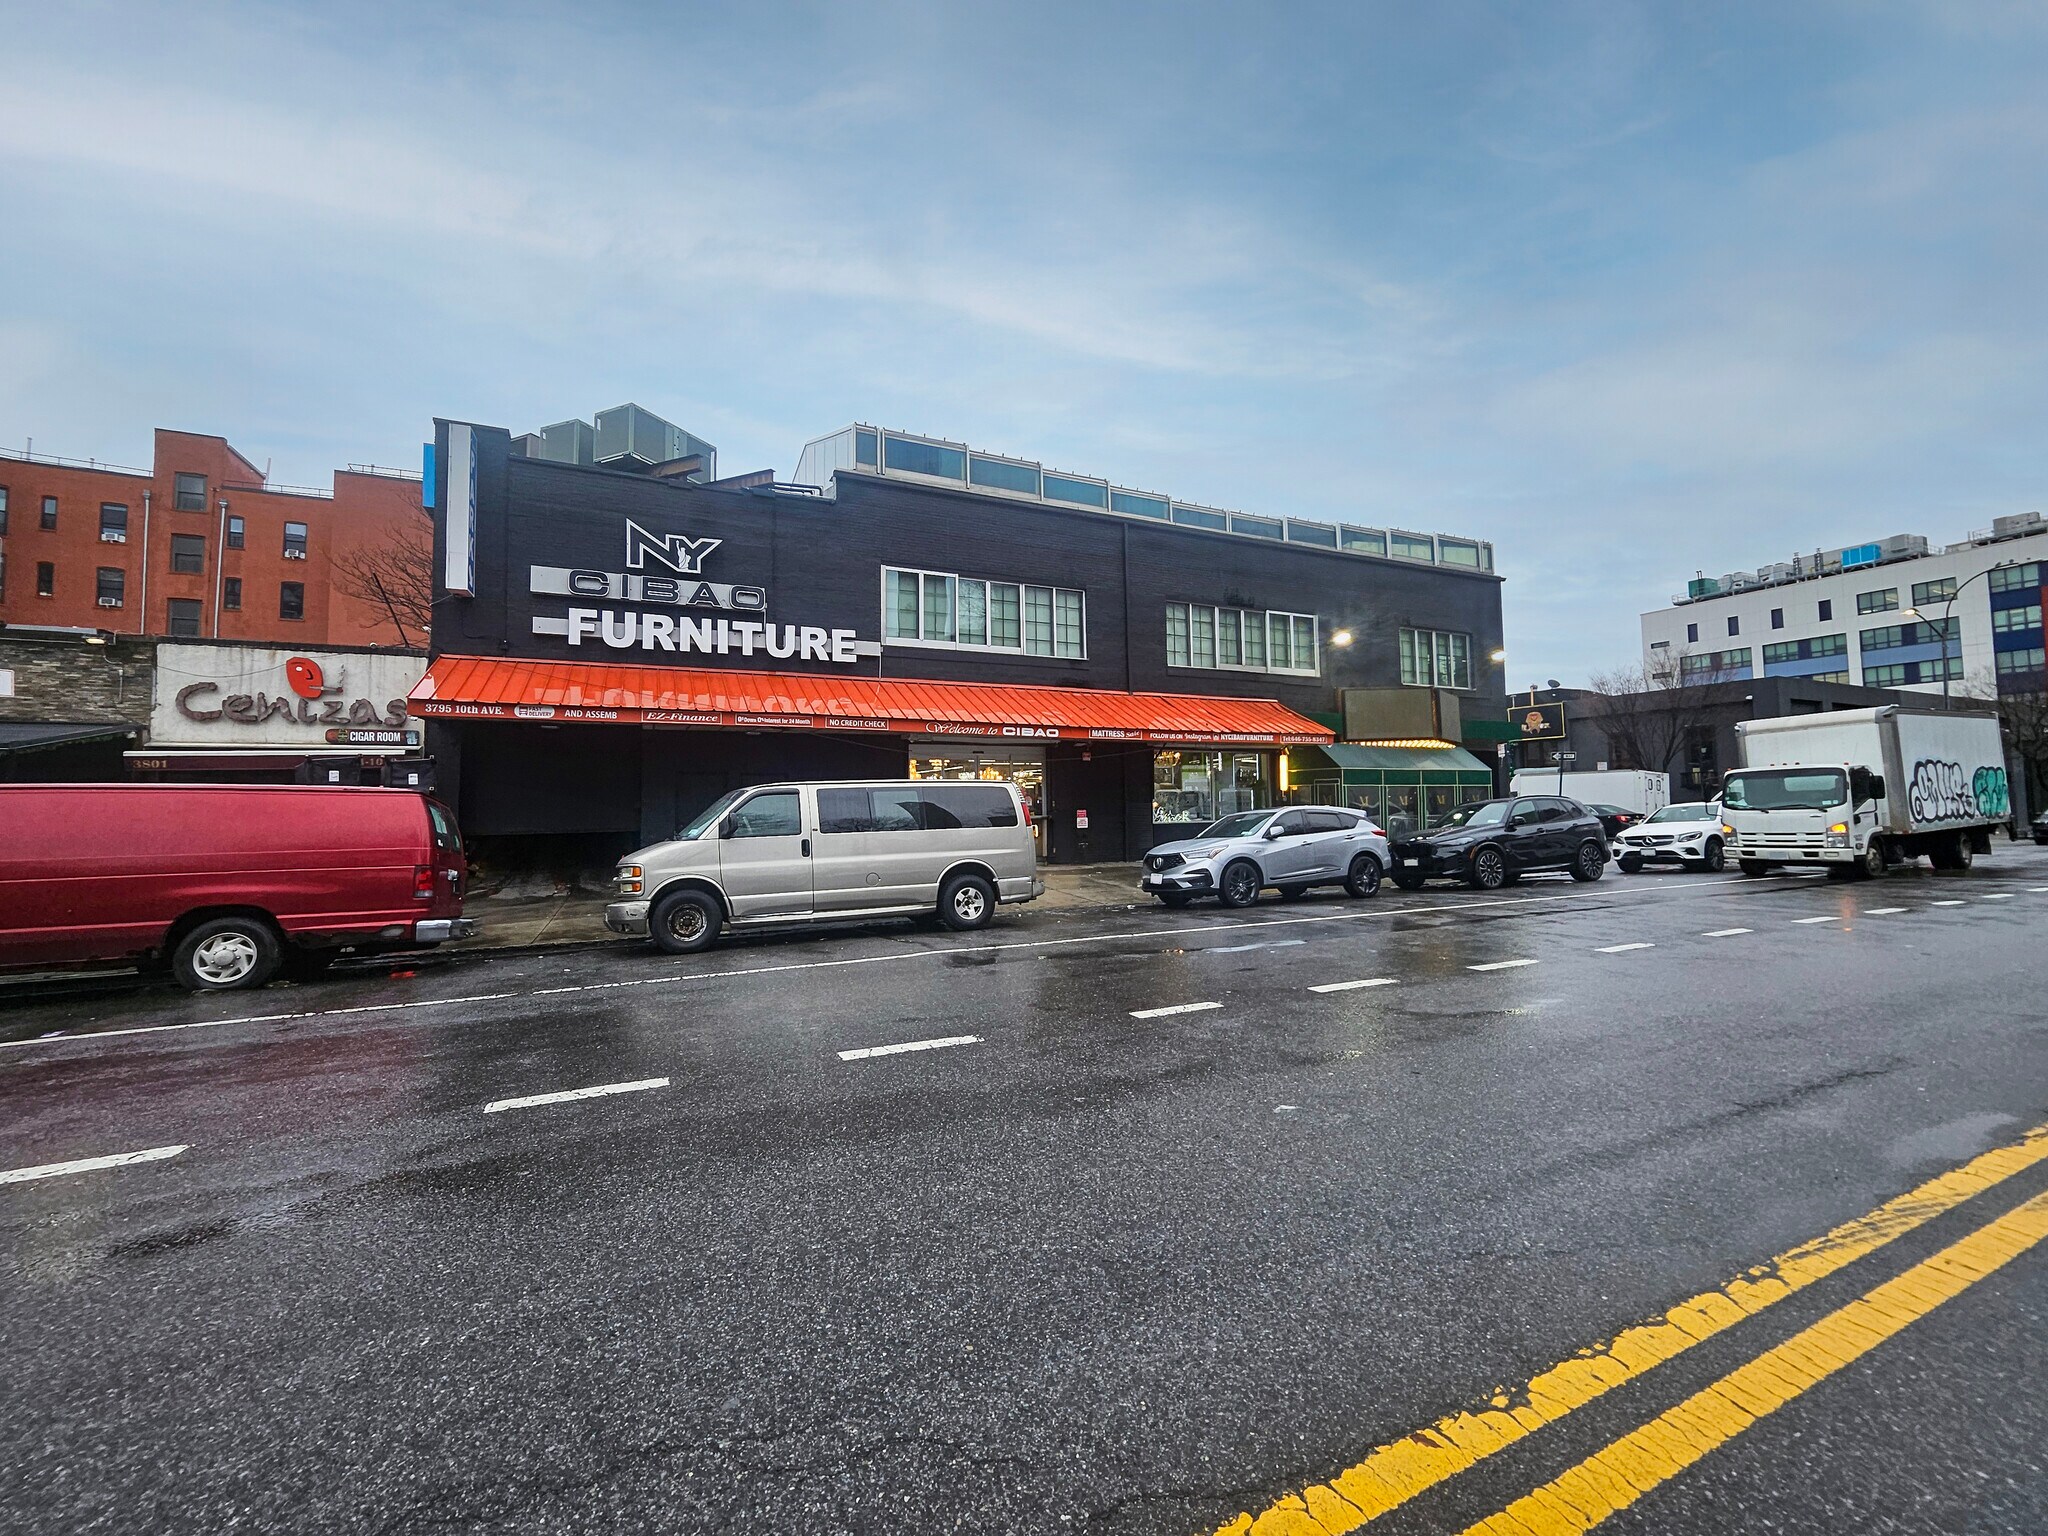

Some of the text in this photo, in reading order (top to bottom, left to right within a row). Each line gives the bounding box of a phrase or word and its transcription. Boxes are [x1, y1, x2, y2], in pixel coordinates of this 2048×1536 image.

[625, 518, 723, 574] NY
[567, 568, 767, 612] CIBAO
[567, 607, 858, 663] FURNITURE
[175, 681, 408, 727] Cenizas
[425, 703, 505, 715] 3795 10th AVE.
[565, 709, 618, 719] AND ASSEMB
[646, 711, 718, 722] EZ-Finance
[829, 719, 886, 728] NO CREDIT CHECK
[925, 721, 998, 735] Welcome to
[349, 731, 401, 742] CIGAR ROOM
[1002, 726, 1059, 738] CIBAO
[1091, 729, 1125, 738] MATTRESS
[132, 759, 168, 769] 3801
